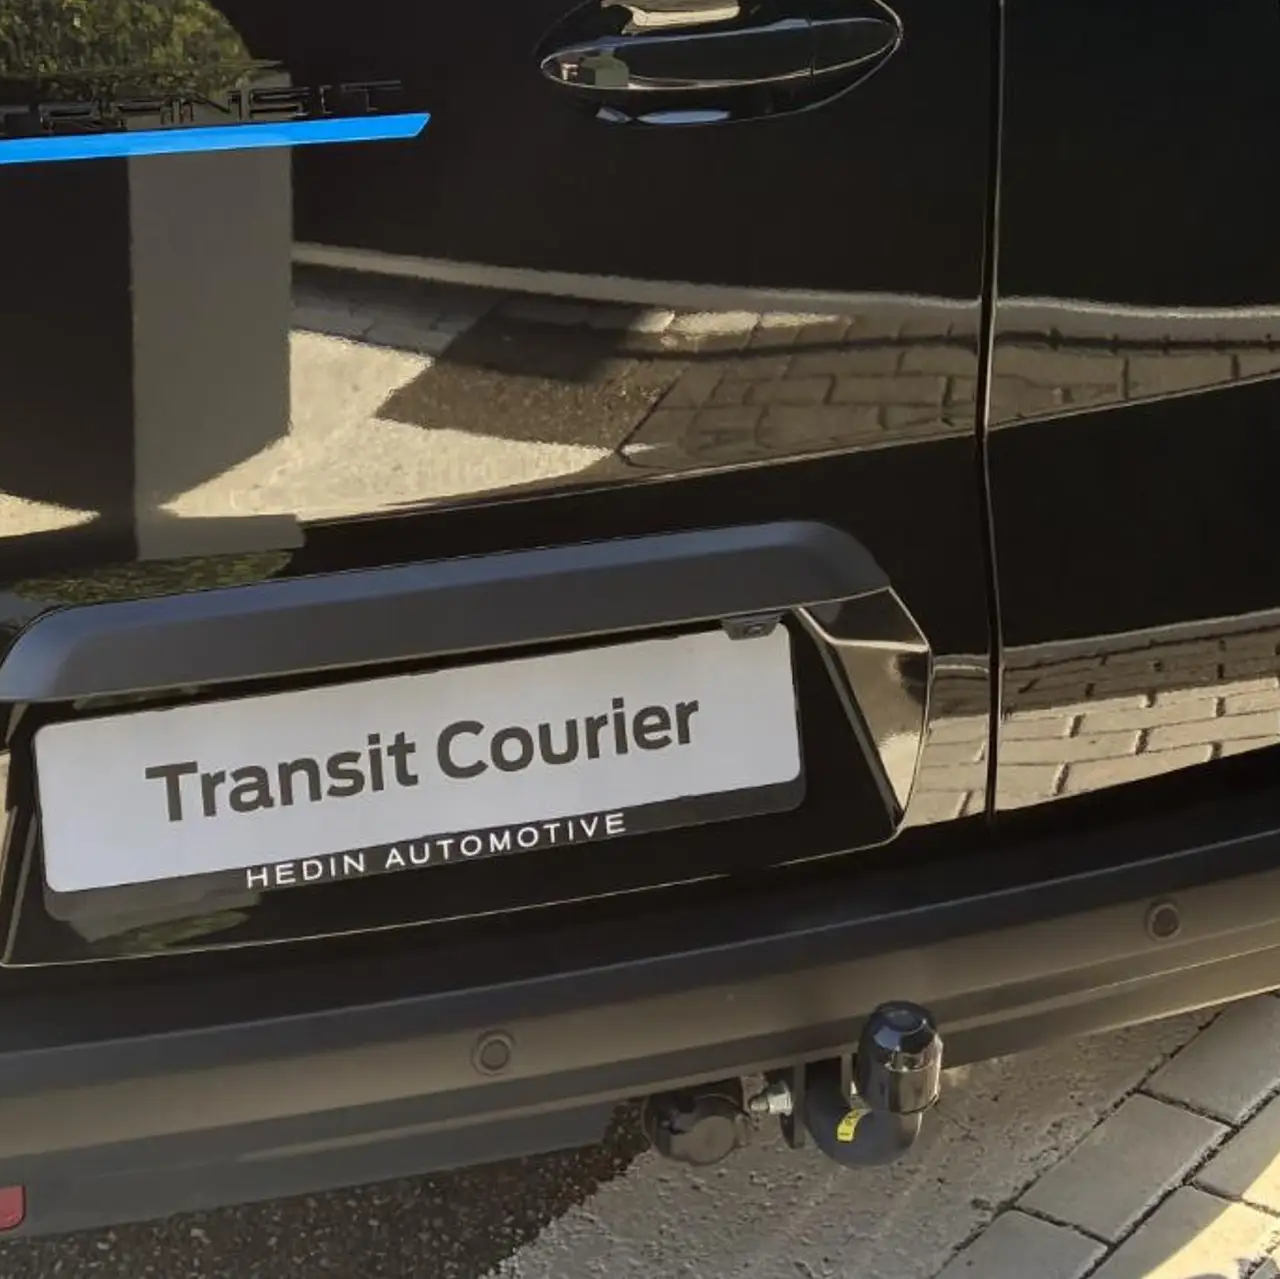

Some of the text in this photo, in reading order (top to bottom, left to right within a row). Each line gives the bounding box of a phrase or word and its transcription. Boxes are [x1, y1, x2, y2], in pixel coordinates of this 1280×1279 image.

[144, 697, 700, 823] Transit Courier
[245, 811, 628, 890] HEDIN AUTOMOTIVE
